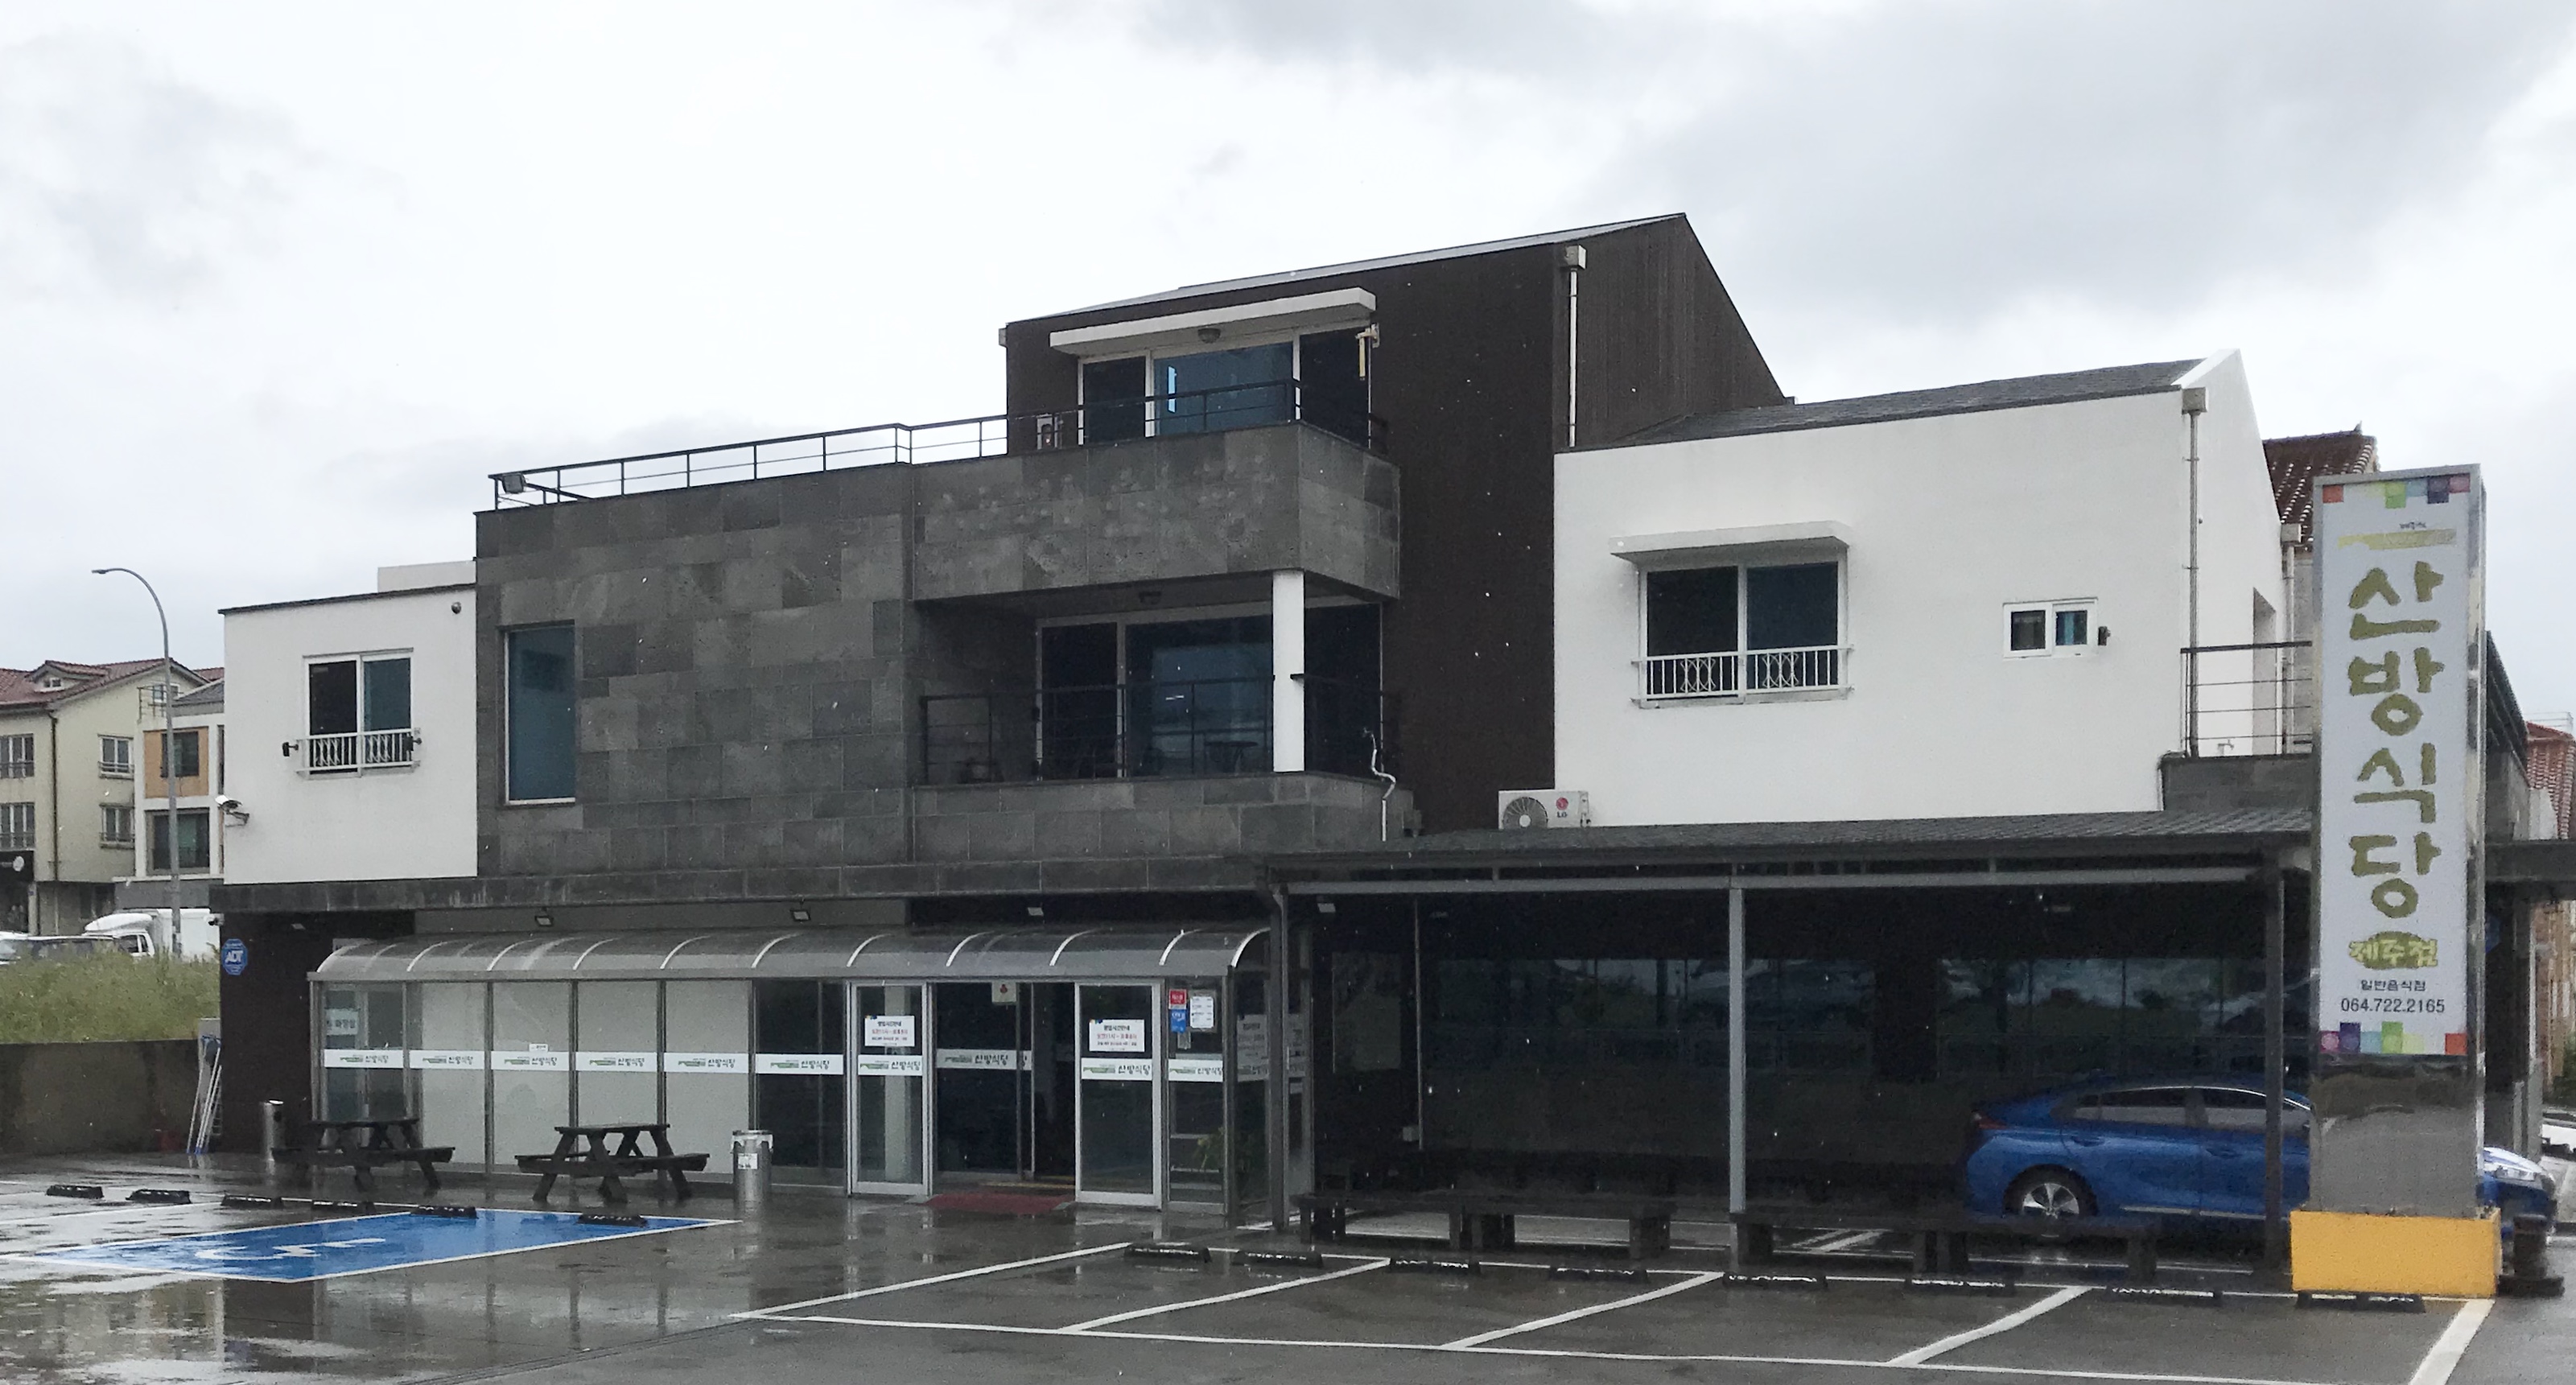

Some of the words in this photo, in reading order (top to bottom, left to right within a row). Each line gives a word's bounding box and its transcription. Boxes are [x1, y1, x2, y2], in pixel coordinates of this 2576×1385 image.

[2348, 561, 2444, 918] 산방식당
[225, 950, 243, 962] ADT
[2348, 939, 2438, 967] 제주점
[2361, 979, 2426, 991] 일반음식점
[2340, 998, 2445, 1012] 064.722.2165
[801, 1060, 830, 1070] 산방식당
[891, 1061, 921, 1071] 산방식당
[975, 1054, 1008, 1066] 산방식당
[1118, 1065, 1151, 1076] 산방식당
